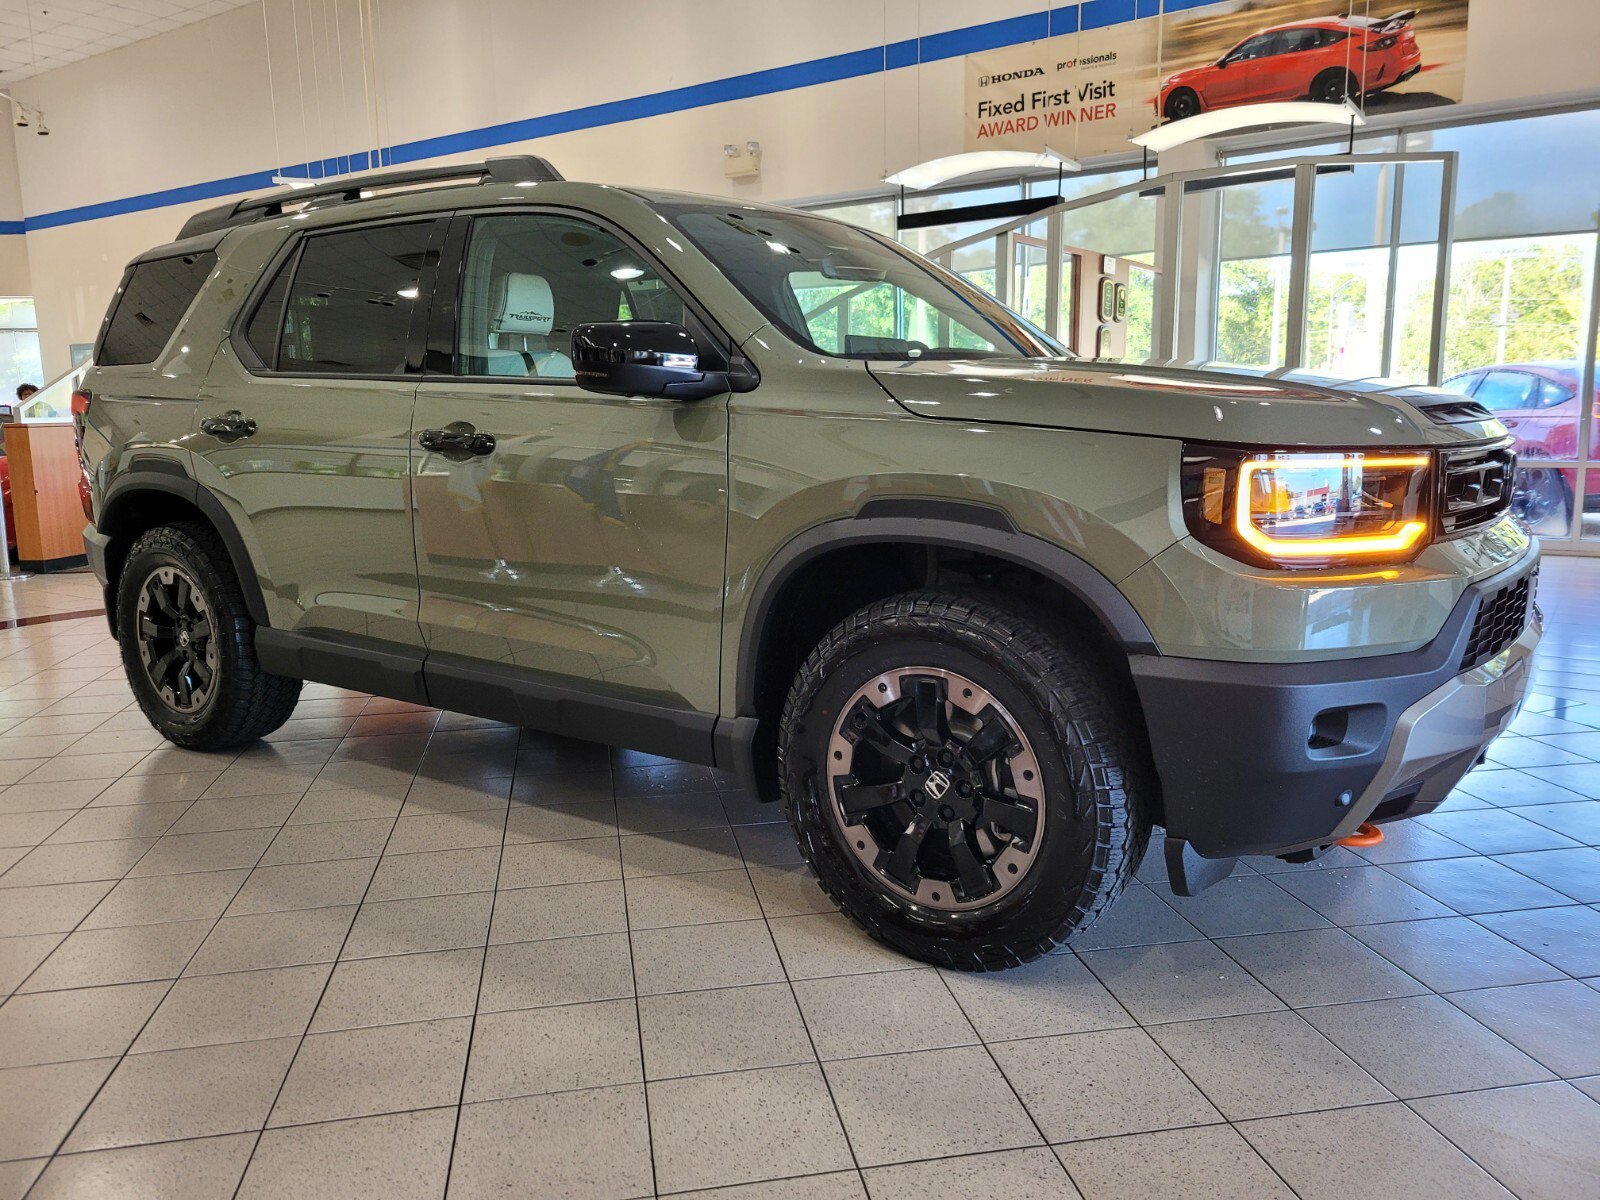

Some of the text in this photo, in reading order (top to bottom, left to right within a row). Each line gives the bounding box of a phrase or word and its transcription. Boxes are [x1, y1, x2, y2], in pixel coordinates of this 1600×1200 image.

[991, 67, 1046, 84] HONDA
[977, 79, 1116, 119] Fixed First Visit
[977, 102, 1117, 139] AWARD WINNER
